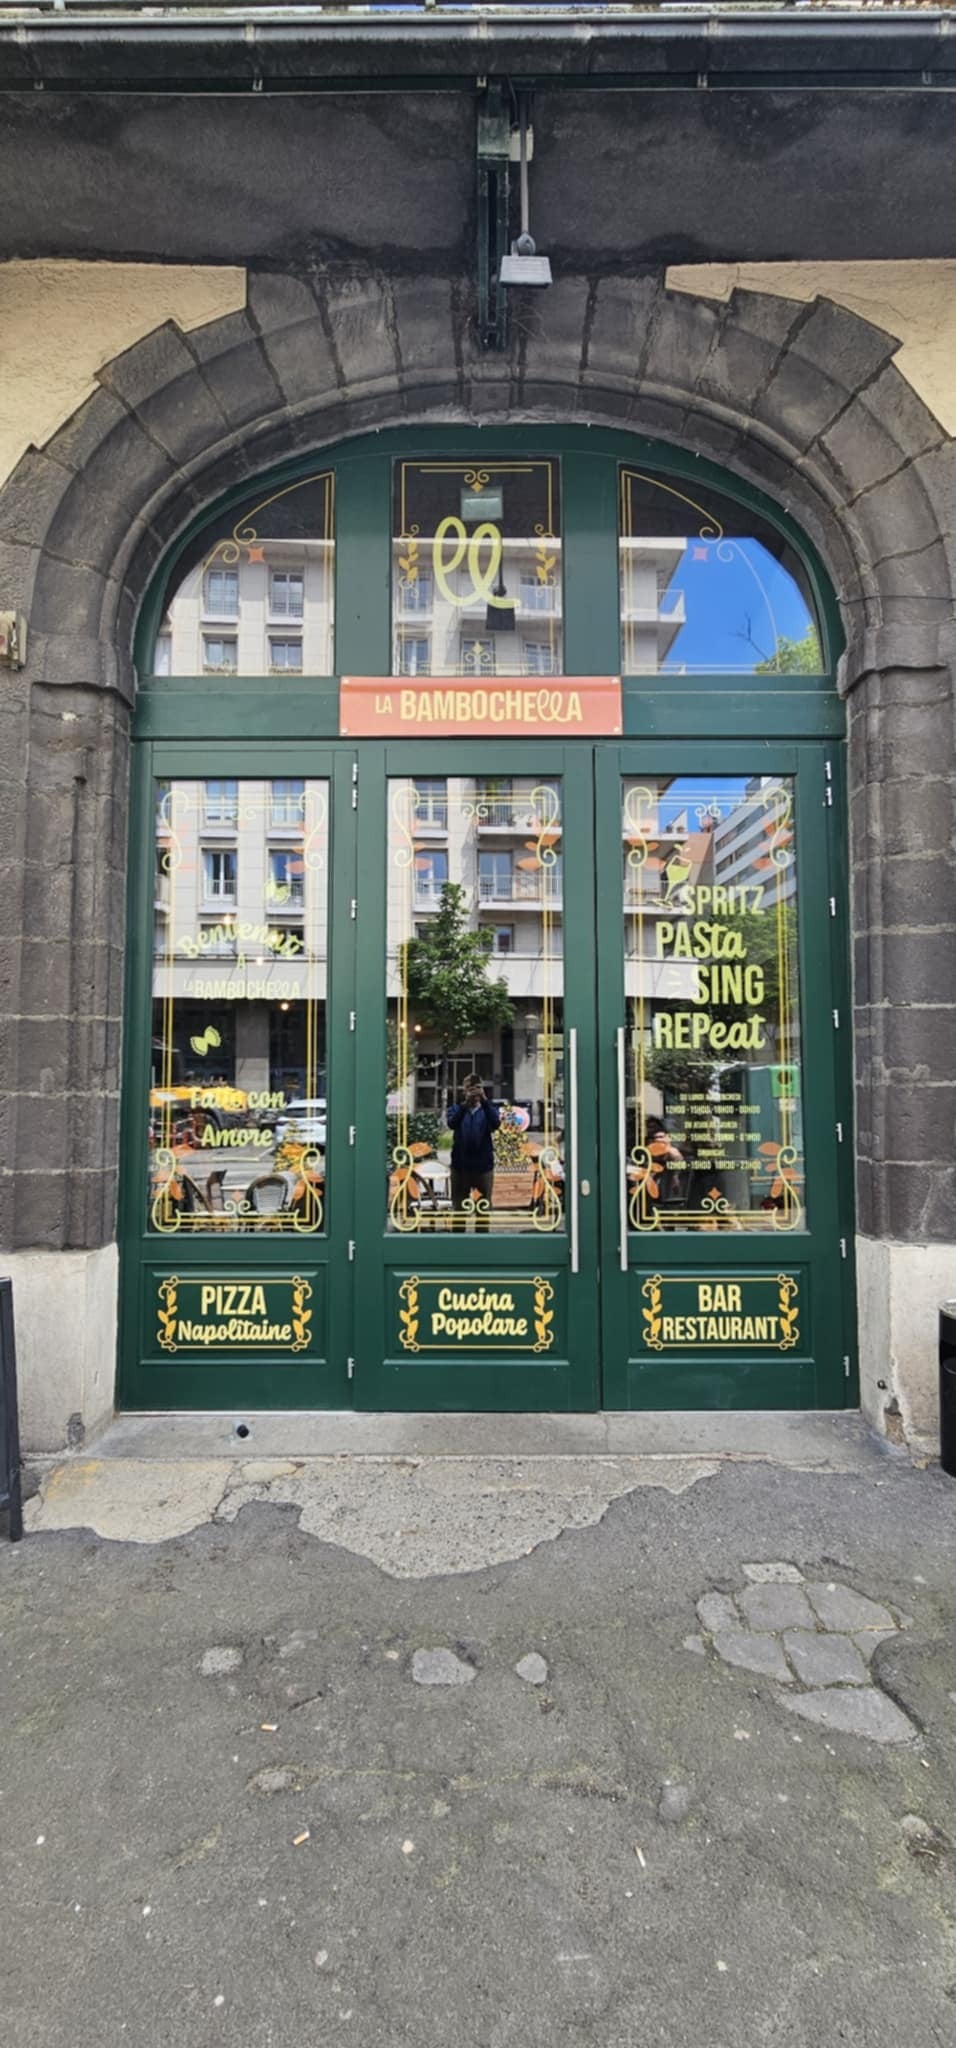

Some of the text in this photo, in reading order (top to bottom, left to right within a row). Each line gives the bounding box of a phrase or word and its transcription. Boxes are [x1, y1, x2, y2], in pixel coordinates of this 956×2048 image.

[375, 695, 393, 714] LA
[680, 885, 765, 915] SPRITZ
[691, 964, 765, 1005] SING
[248, 1090, 287, 1109] con
[201, 1124, 273, 1147] Amore
[201, 1285, 267, 1315] PIZZA
[438, 1288, 515, 1311] Cucina
[698, 1284, 742, 1312] BAR
[177, 1318, 292, 1345] Napolitaine
[431, 1311, 528, 1340] Popolare
[662, 1316, 778, 1340] RESTAURANT
